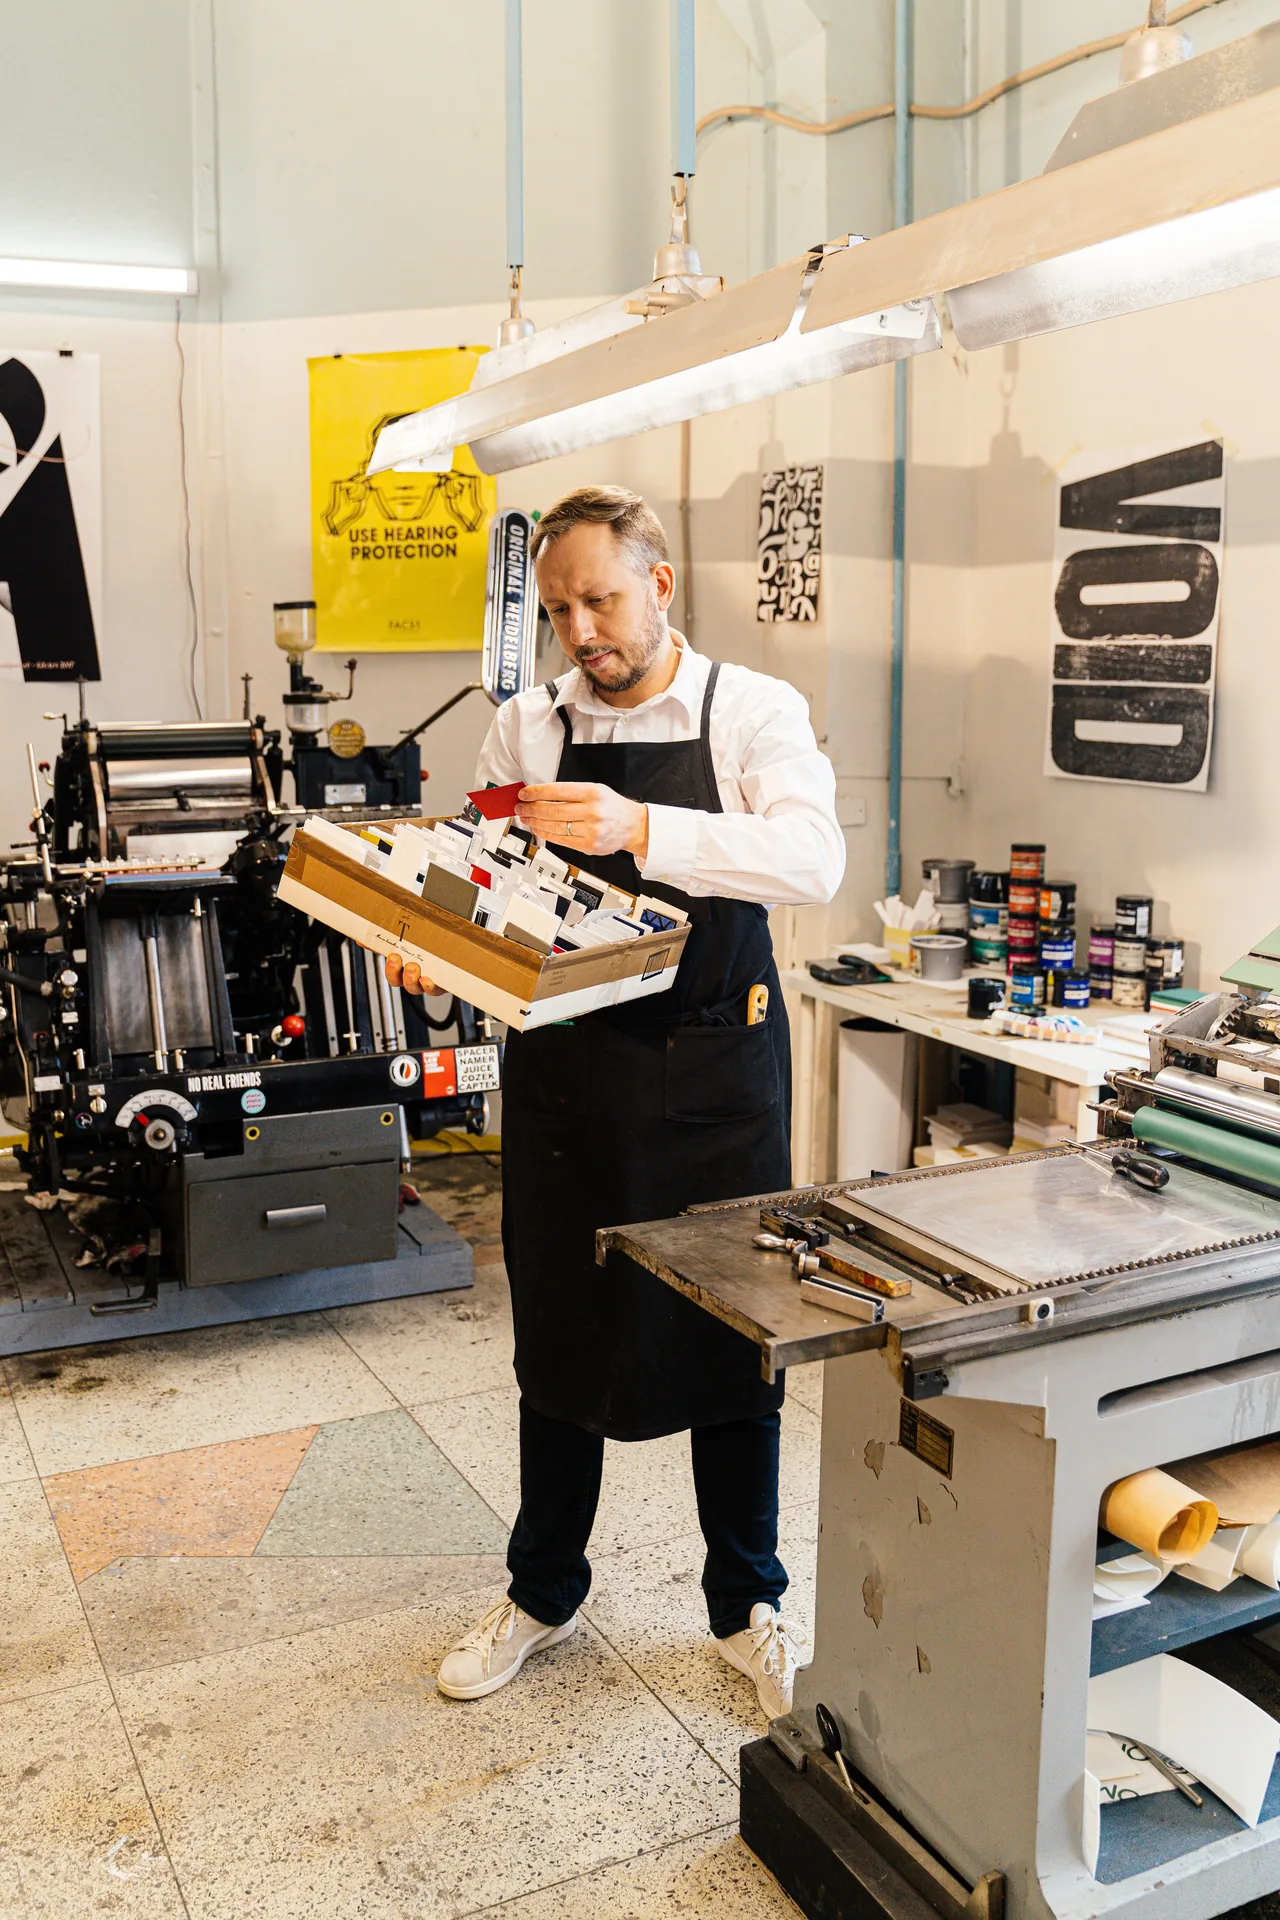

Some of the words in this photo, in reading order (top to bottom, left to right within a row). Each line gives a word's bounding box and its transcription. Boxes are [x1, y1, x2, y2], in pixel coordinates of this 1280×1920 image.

[349, 528, 377, 543] USE
[385, 525, 458, 541] HEARING
[351, 543, 457, 560] PROTECTION
[507, 524, 525, 596] ORIGINAL
[1051, 439, 1223, 784] VOID
[501, 601, 521, 691] HEIDELBERG
[457, 1047, 496, 1057] SPACER
[460, 1055, 495, 1065] NAMER
[463, 1064, 493, 1074] JUICE
[187, 1076, 202, 1093] NO
[202, 1074, 225, 1092] REAL
[225, 1071, 262, 1089] FRIENDS
[460, 1080, 499, 1091] CAPTEK
[461, 1073, 495, 1083] COZEK
